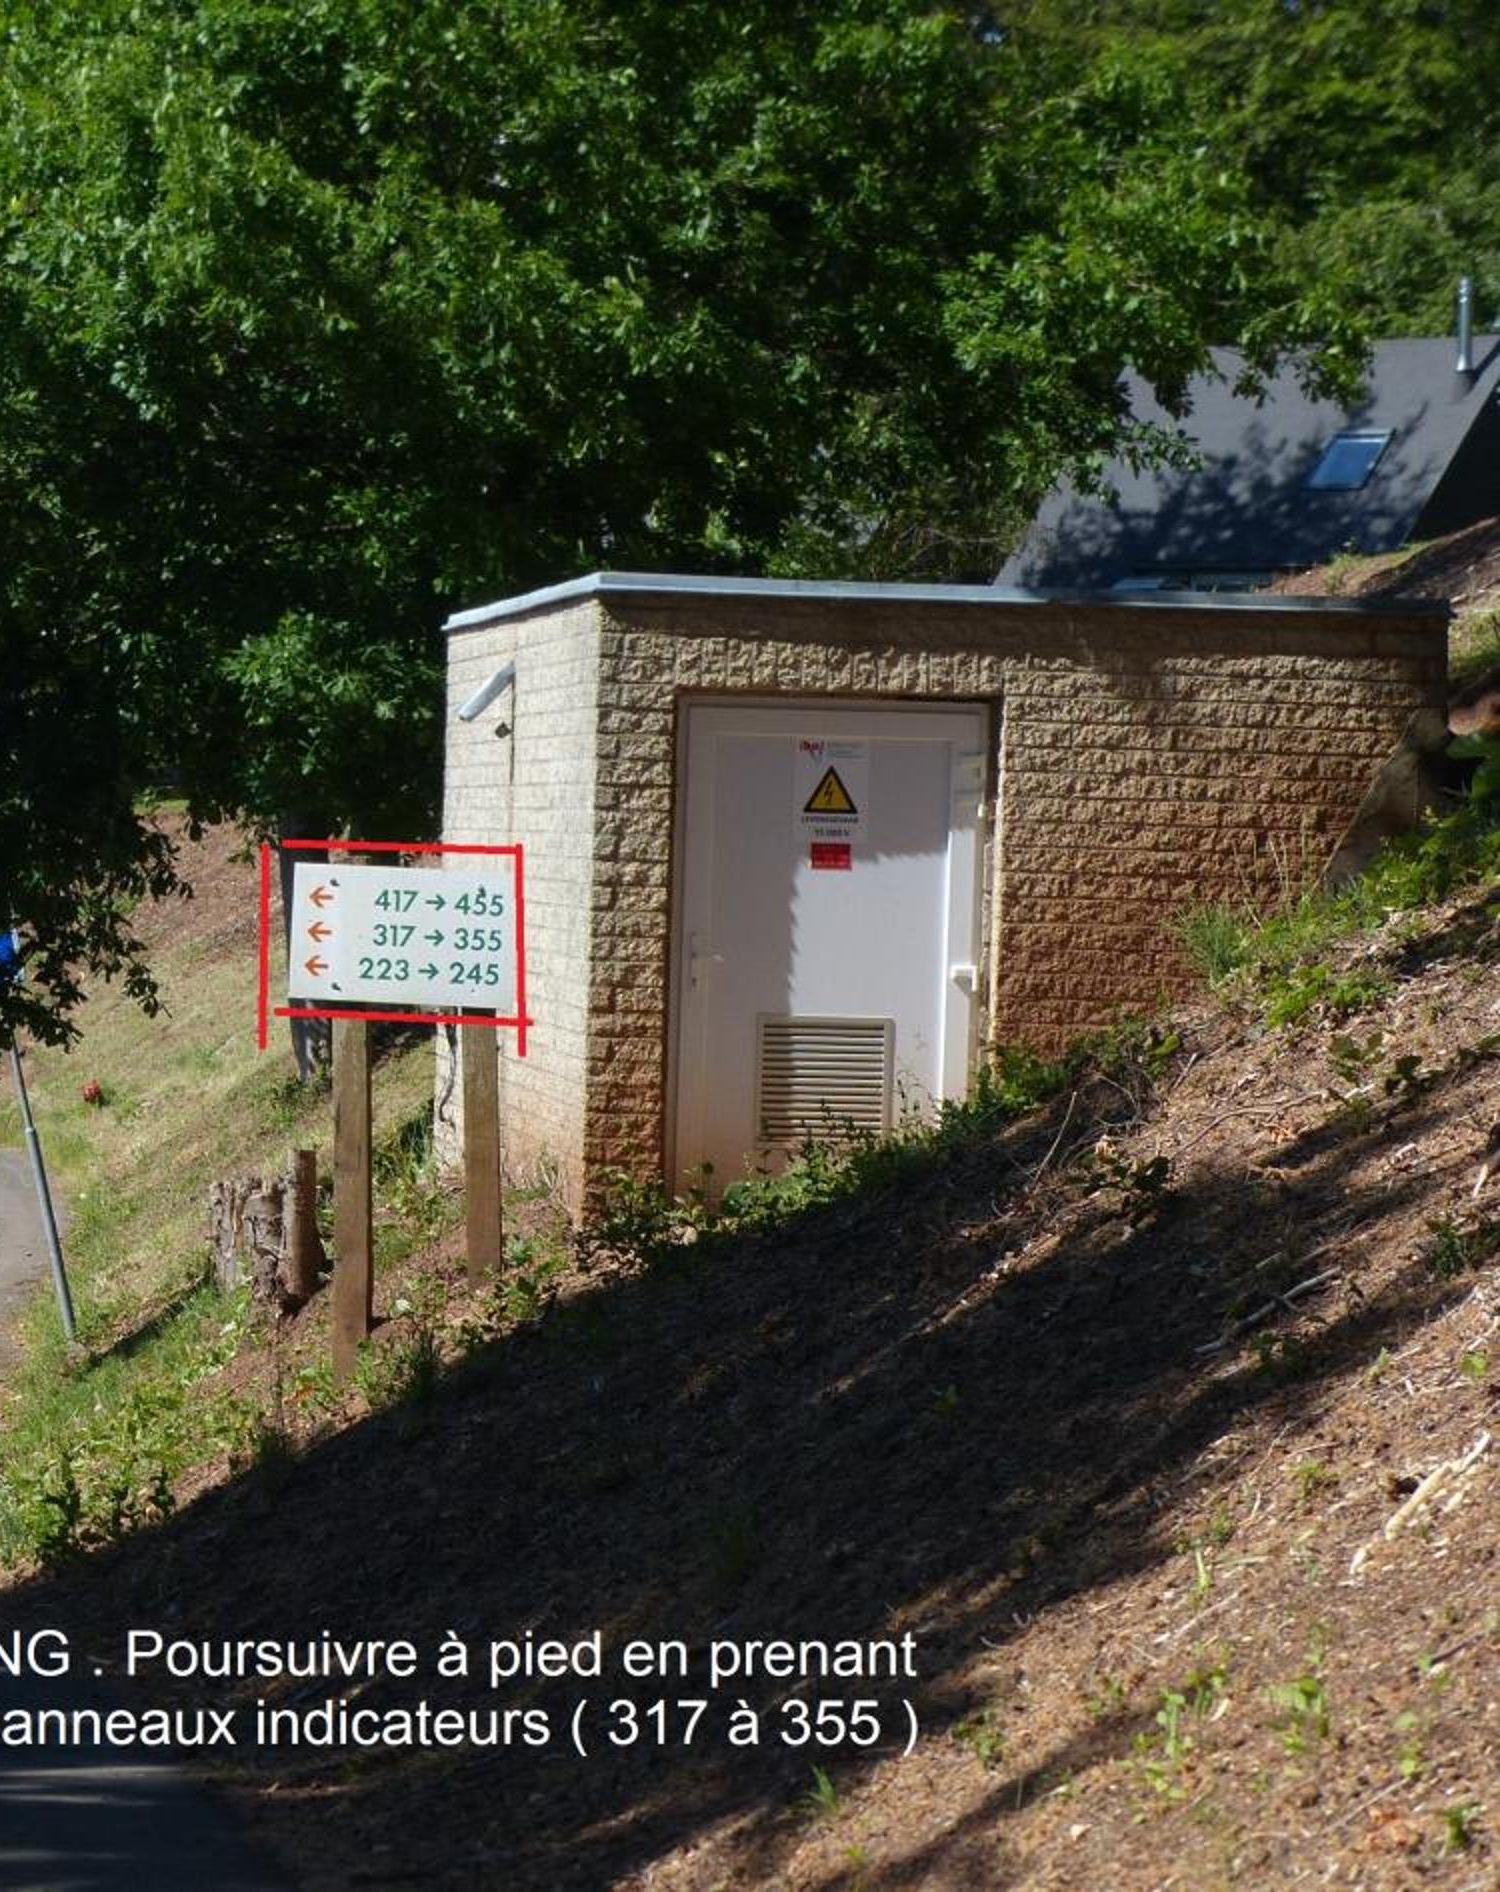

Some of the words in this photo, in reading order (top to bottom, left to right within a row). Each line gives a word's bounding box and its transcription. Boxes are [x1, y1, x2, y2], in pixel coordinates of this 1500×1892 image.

[374, 889, 419, 912] 417
[454, 893, 503, 917] 455
[373, 924, 417, 947] 317
[454, 928, 502, 951] 355
[358, 957, 409, 981] 223
[450, 961, 499, 985] 245
